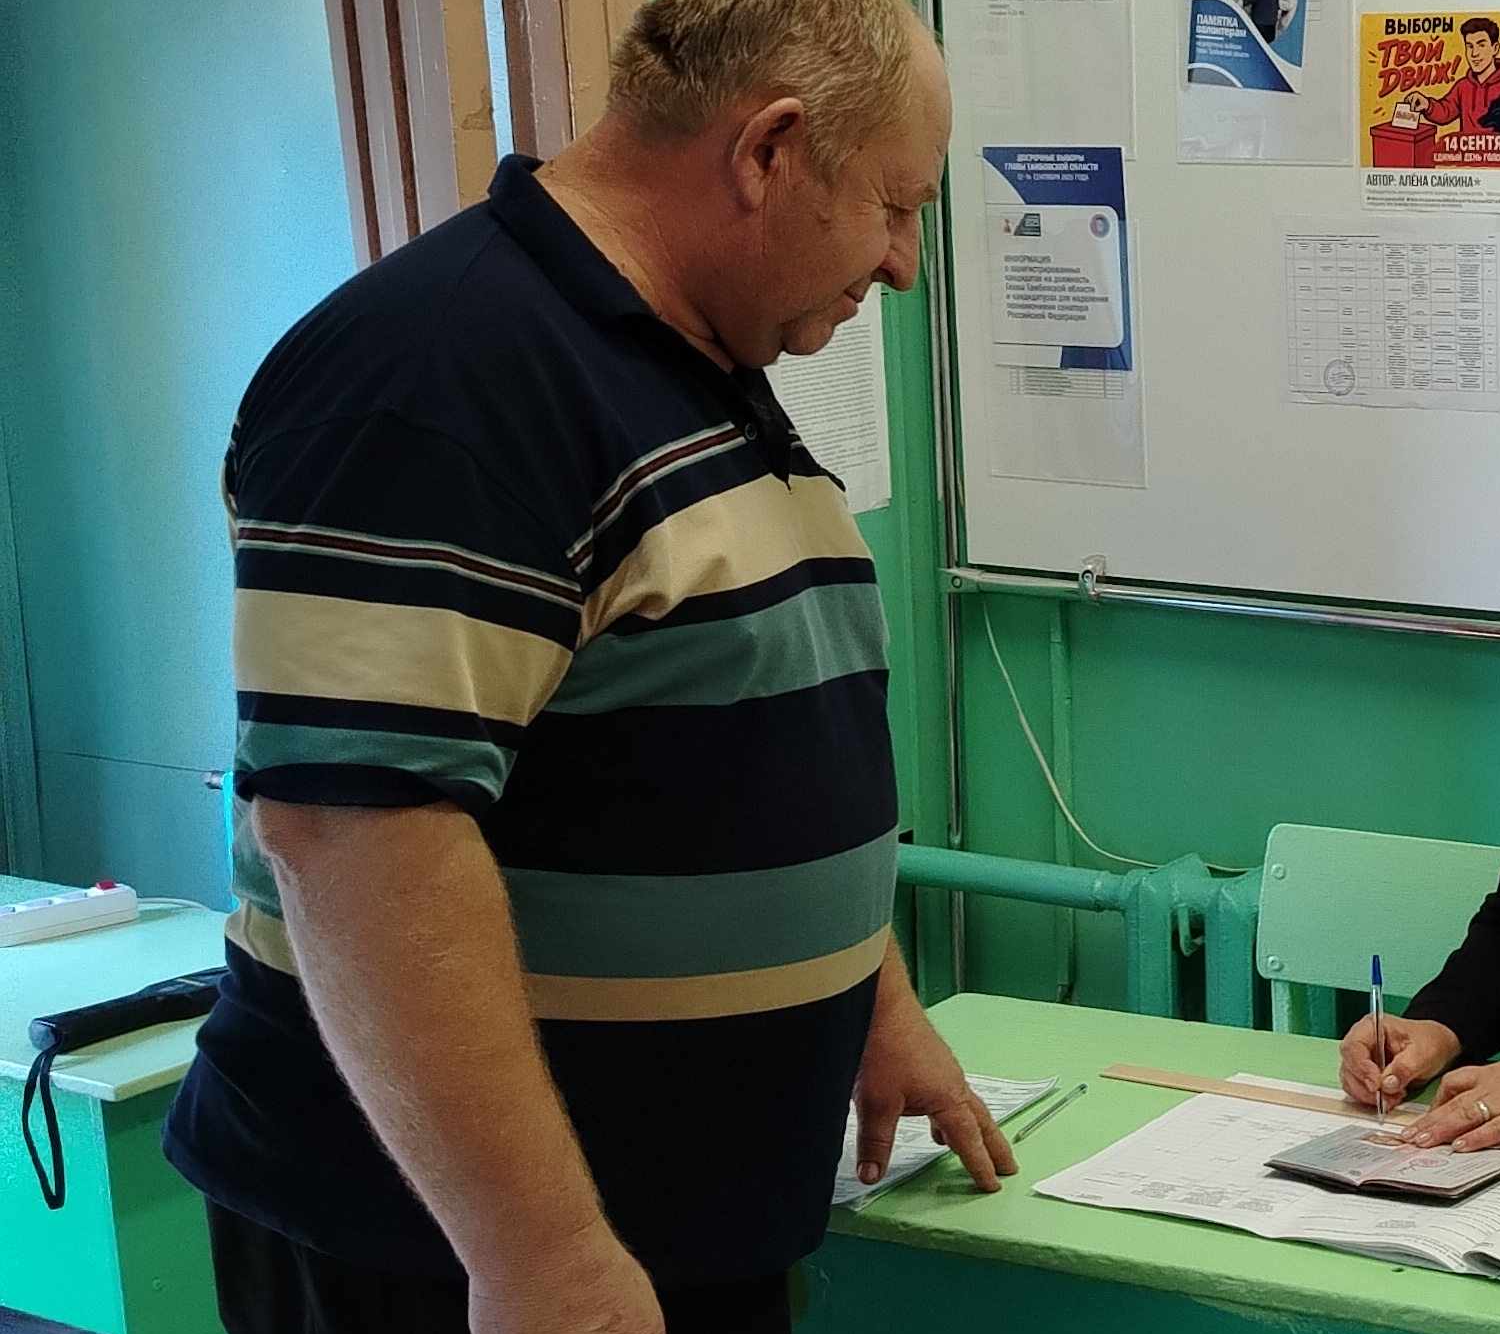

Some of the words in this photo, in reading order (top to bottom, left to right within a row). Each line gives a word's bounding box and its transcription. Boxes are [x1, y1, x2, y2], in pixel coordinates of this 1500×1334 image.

[1197, 14, 1238, 28] ПАМЯТКА
[1385, 17, 1453, 35] ВЫБОРЫ
[1378, 35, 1444, 67] ТВОЙ
[1444, 137, 1457, 151] 14
[1366, 174, 1397, 186] АВТОР:
[1399, 173, 1429, 187] АЛЁНА
